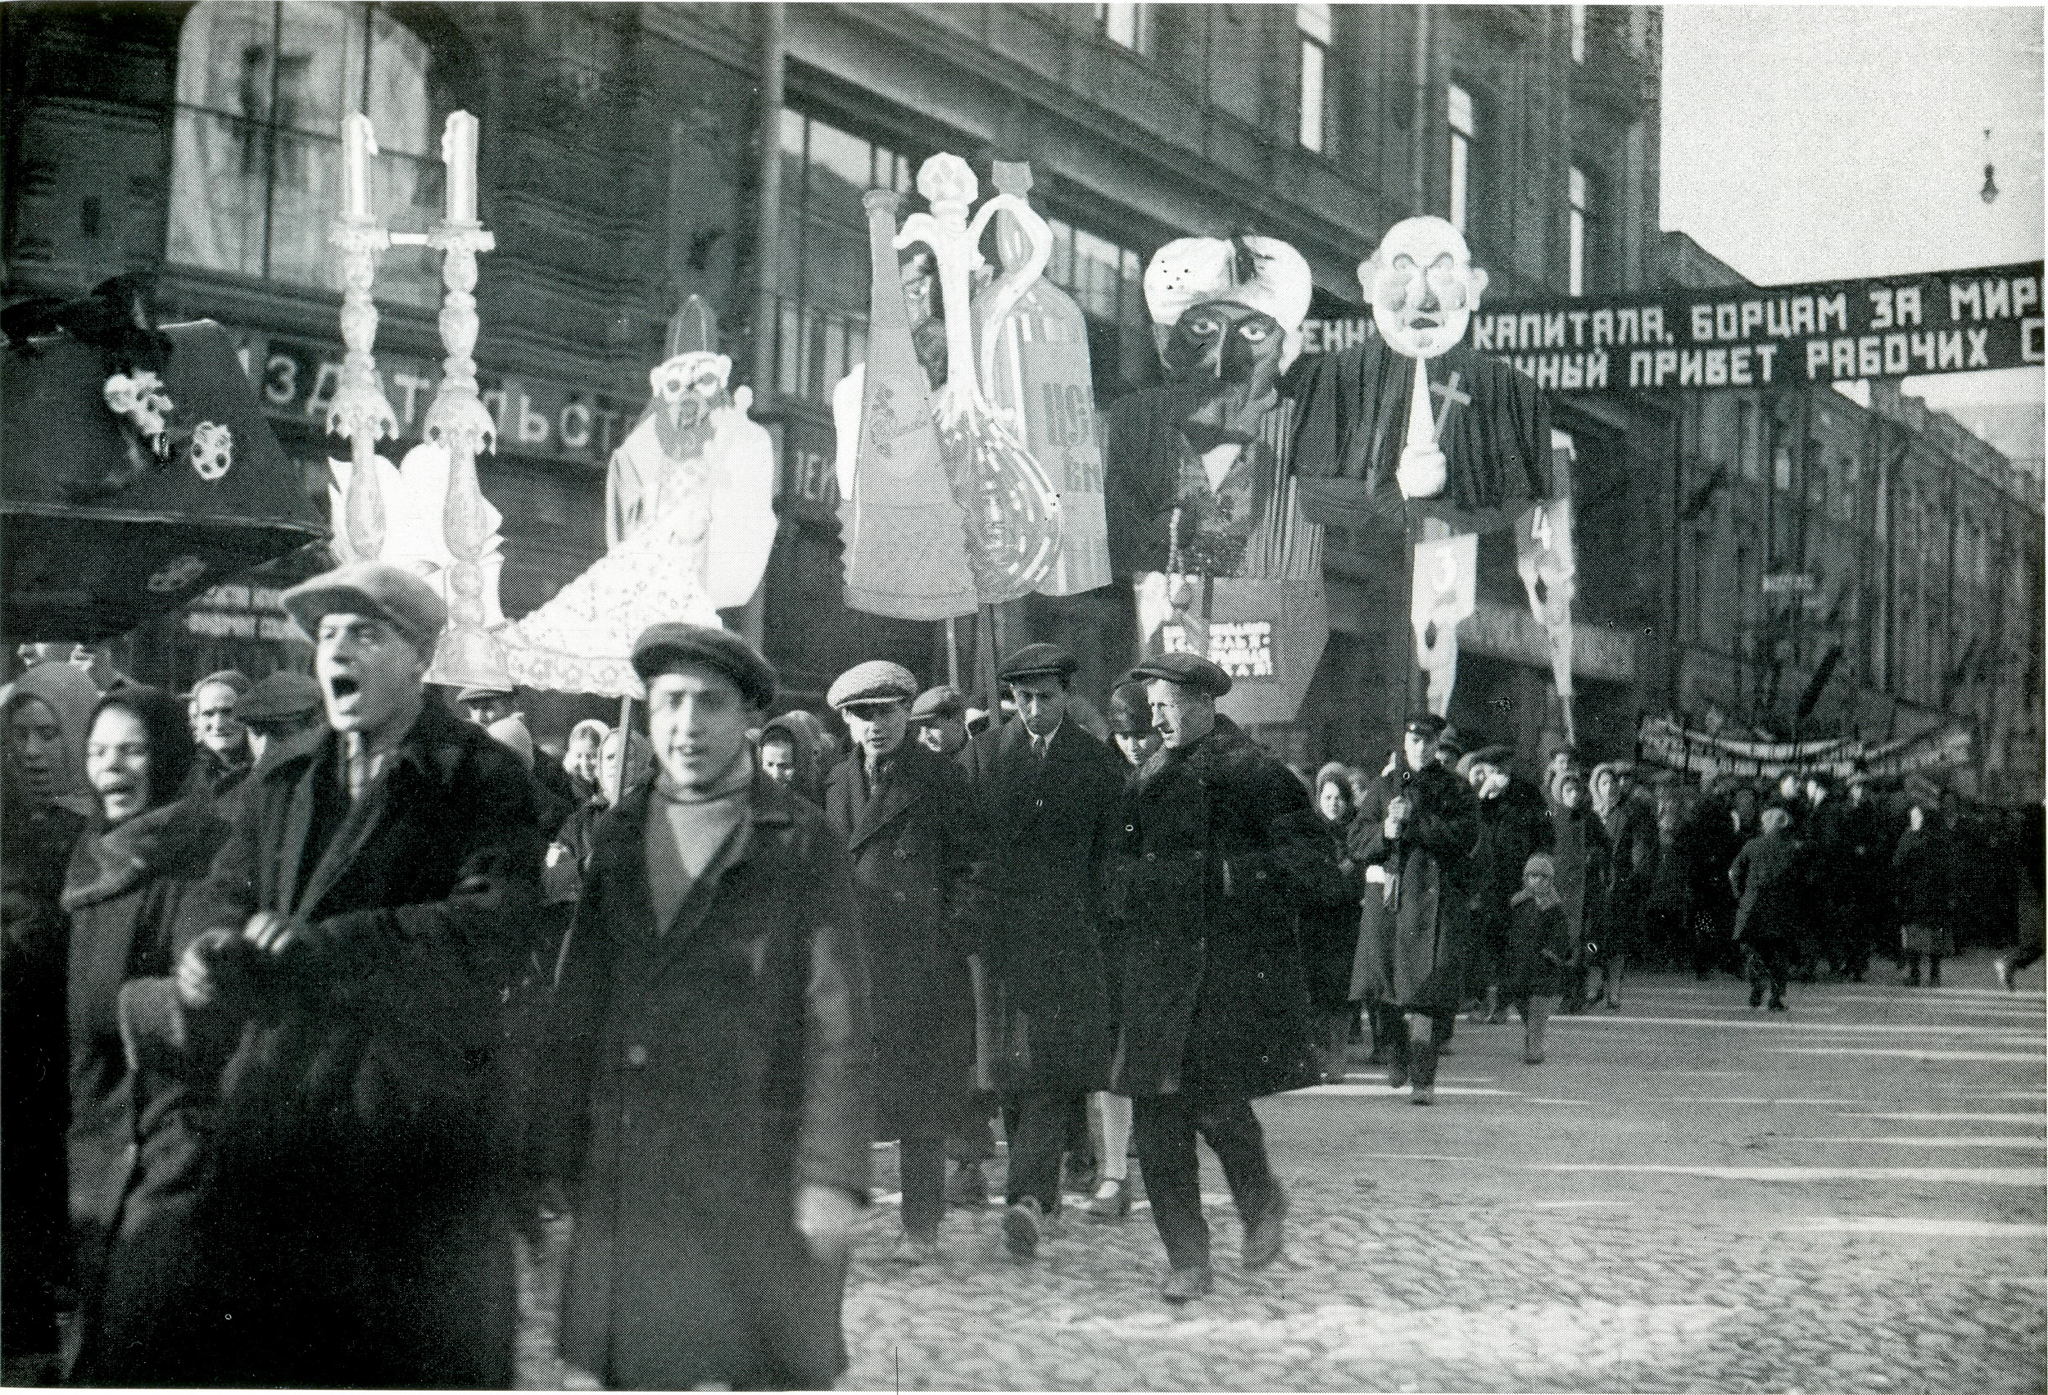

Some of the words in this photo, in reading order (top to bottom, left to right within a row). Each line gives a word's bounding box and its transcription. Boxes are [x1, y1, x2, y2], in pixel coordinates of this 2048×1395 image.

[1691, 292, 1848, 340] БОРЦАМ
[1869, 286, 1922, 330] ЗА
[1950, 276, 2045, 321] МИР
[1630, 344, 1777, 388] ПРИВЕТ
[1806, 328, 1989, 380] РАБОЧИХ
